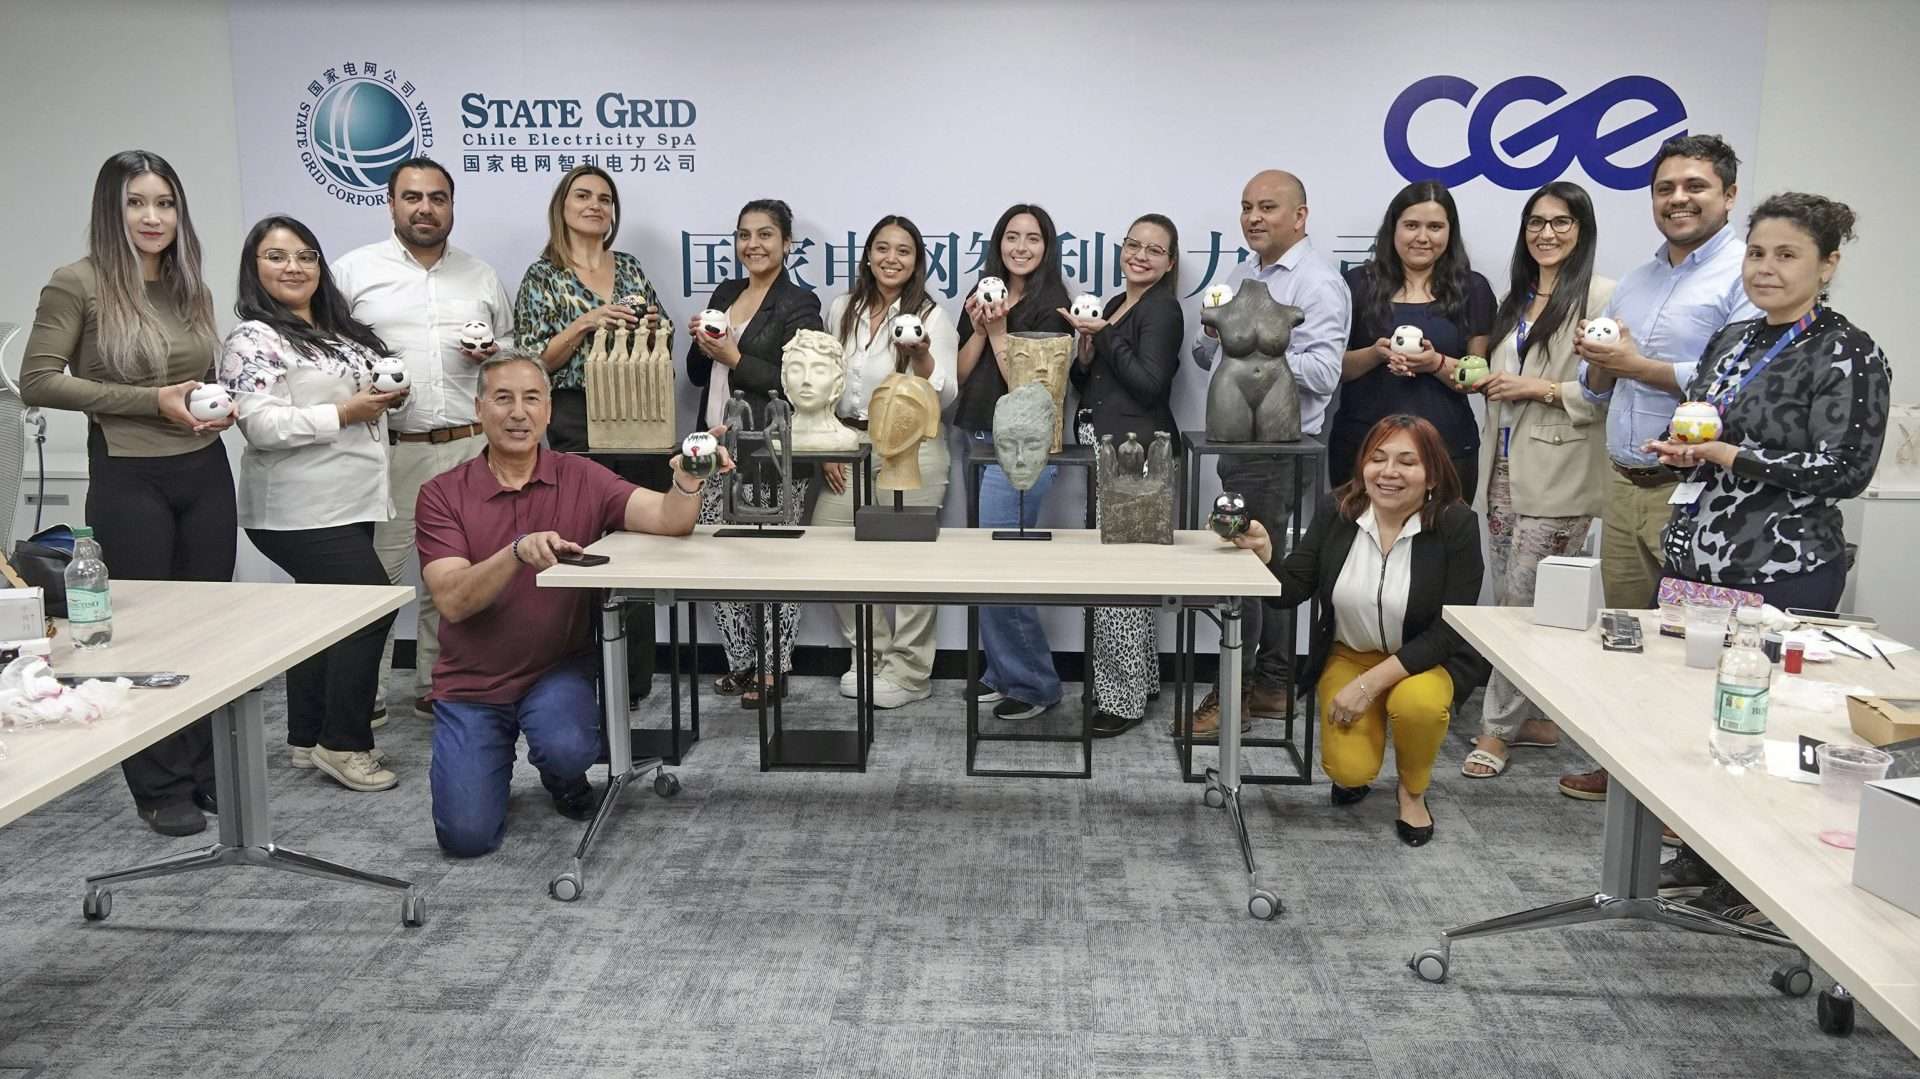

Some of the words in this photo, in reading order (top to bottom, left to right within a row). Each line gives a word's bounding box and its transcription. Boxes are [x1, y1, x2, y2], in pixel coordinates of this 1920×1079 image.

[307, 61, 416, 98] 国家电网公司
[296, 101, 311, 149] STATE
[416, 101, 433, 148] CHINA
[461, 92, 583, 129] STATE
[596, 92, 697, 129] GRID
[462, 133, 517, 146] Chile
[528, 133, 646, 148] Electricity
[657, 133, 697, 148] SpA
[301, 151, 327, 186] GRID
[327, 183, 389, 207] CORPOR
